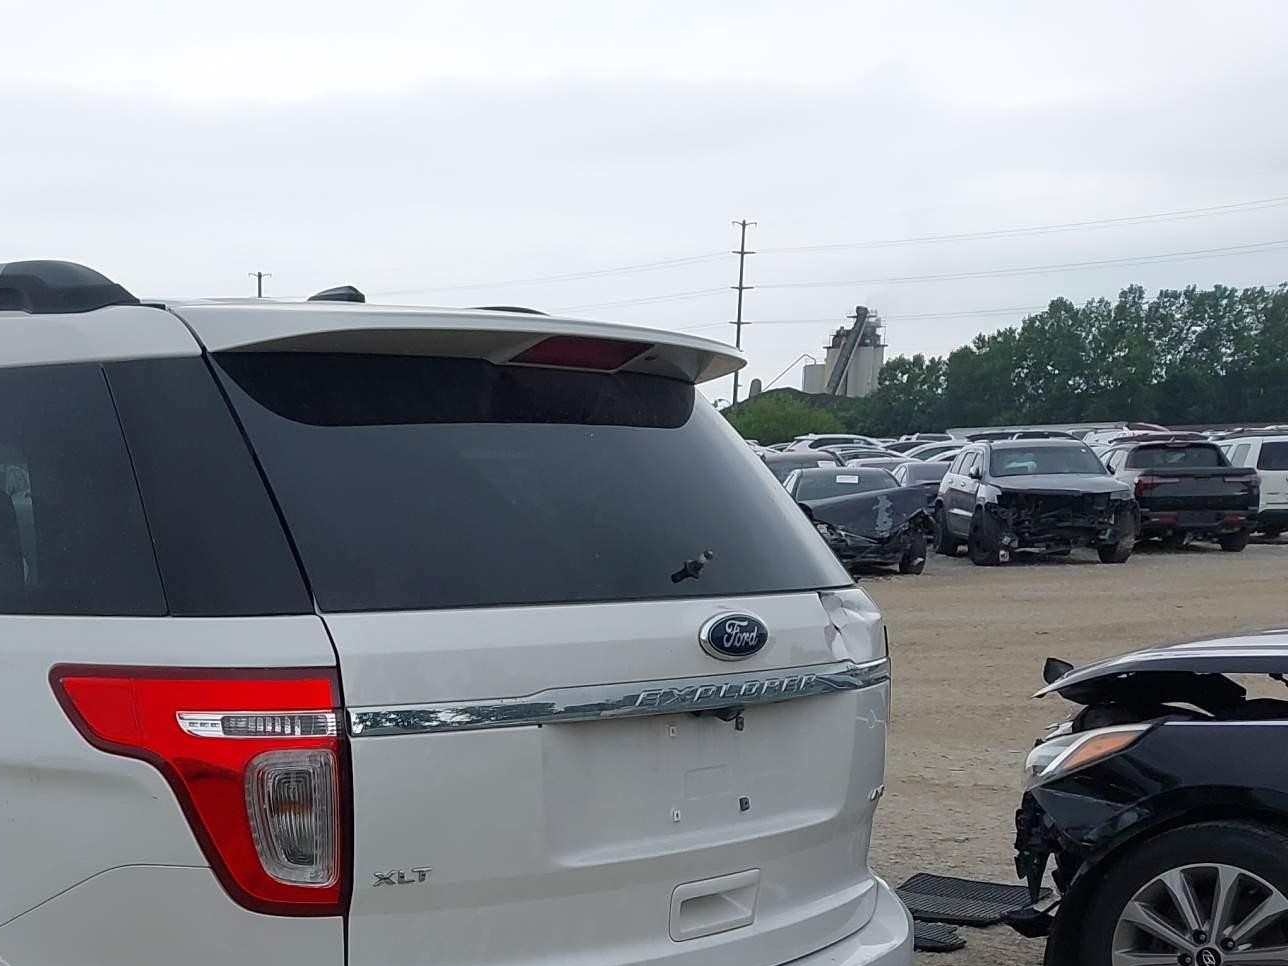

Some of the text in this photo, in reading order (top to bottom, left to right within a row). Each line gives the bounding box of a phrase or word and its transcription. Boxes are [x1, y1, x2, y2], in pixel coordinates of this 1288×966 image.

[723, 620, 759, 648] Ford
[634, 673, 817, 708] EXPLORER
[372, 866, 433, 888] XLT
